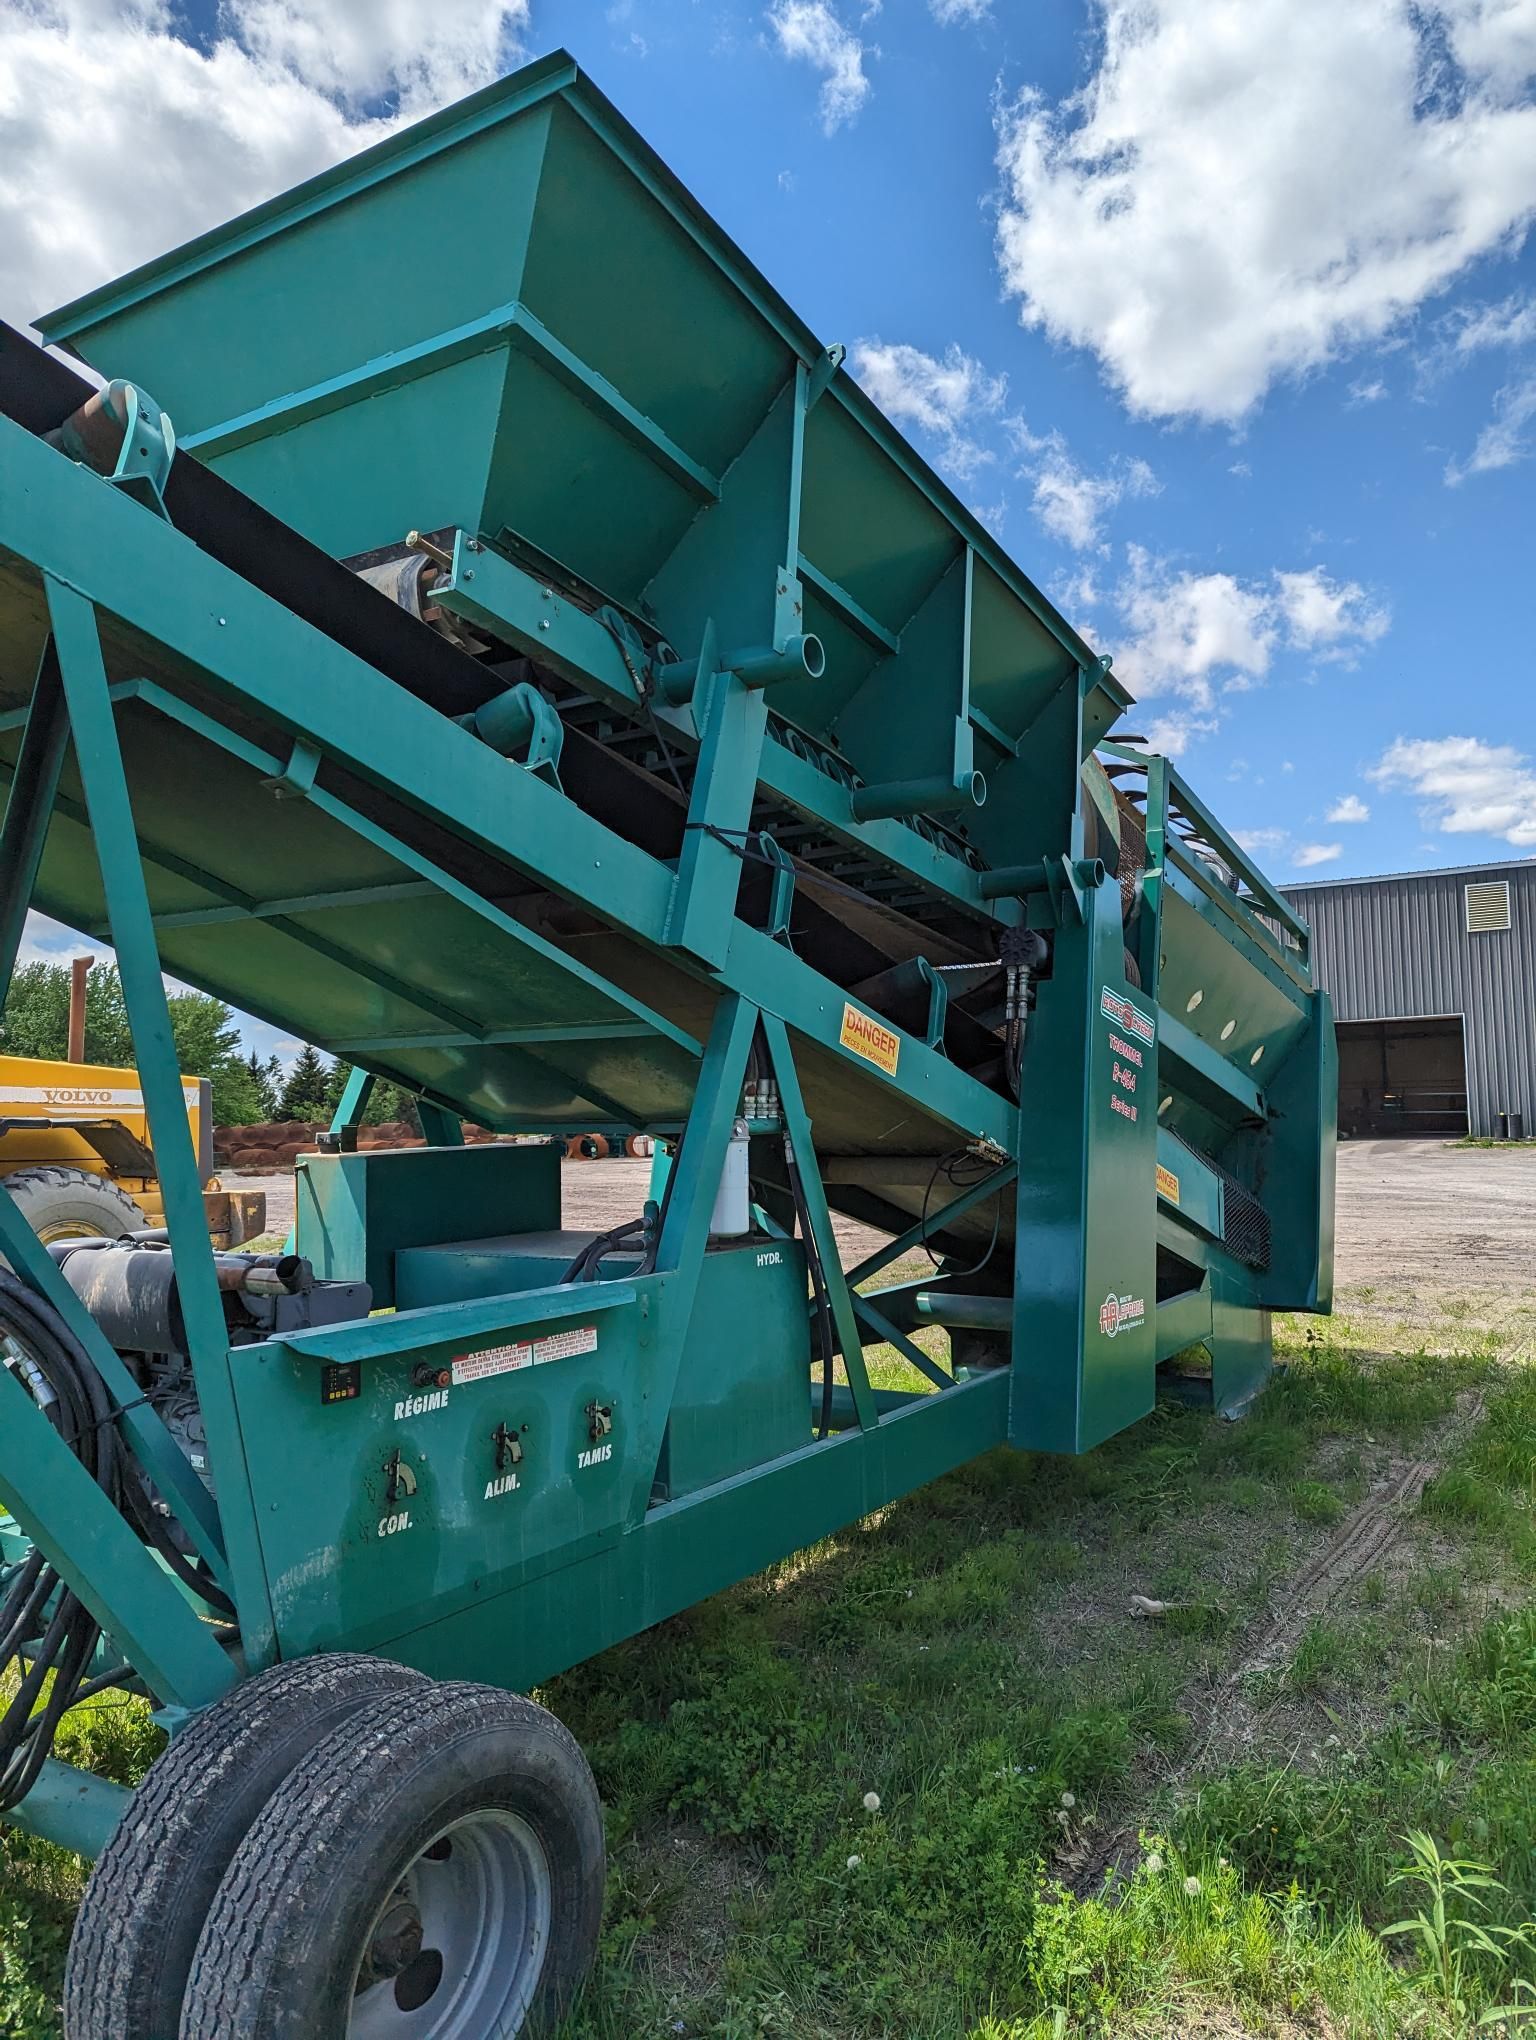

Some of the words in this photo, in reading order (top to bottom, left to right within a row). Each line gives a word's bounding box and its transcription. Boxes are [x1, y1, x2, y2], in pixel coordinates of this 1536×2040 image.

[846, 1010, 896, 1058] DANGER
[860, 1045, 867, 1054] EN
[1109, 1033, 1143, 1068] TROMMEL
[42, 1089, 112, 1103] VOLVO
[756, 1252, 783, 1267] HYDR.
[547, 1328, 584, 1341] ATTENTION
[468, 1344, 518, 1360] ATTENTION
[394, 1389, 449, 1421] RÉGIME
[578, 1444, 612, 1469] TAMIS
[484, 1472, 520, 1500] ALIM.
[377, 1512, 413, 1537] CON.
